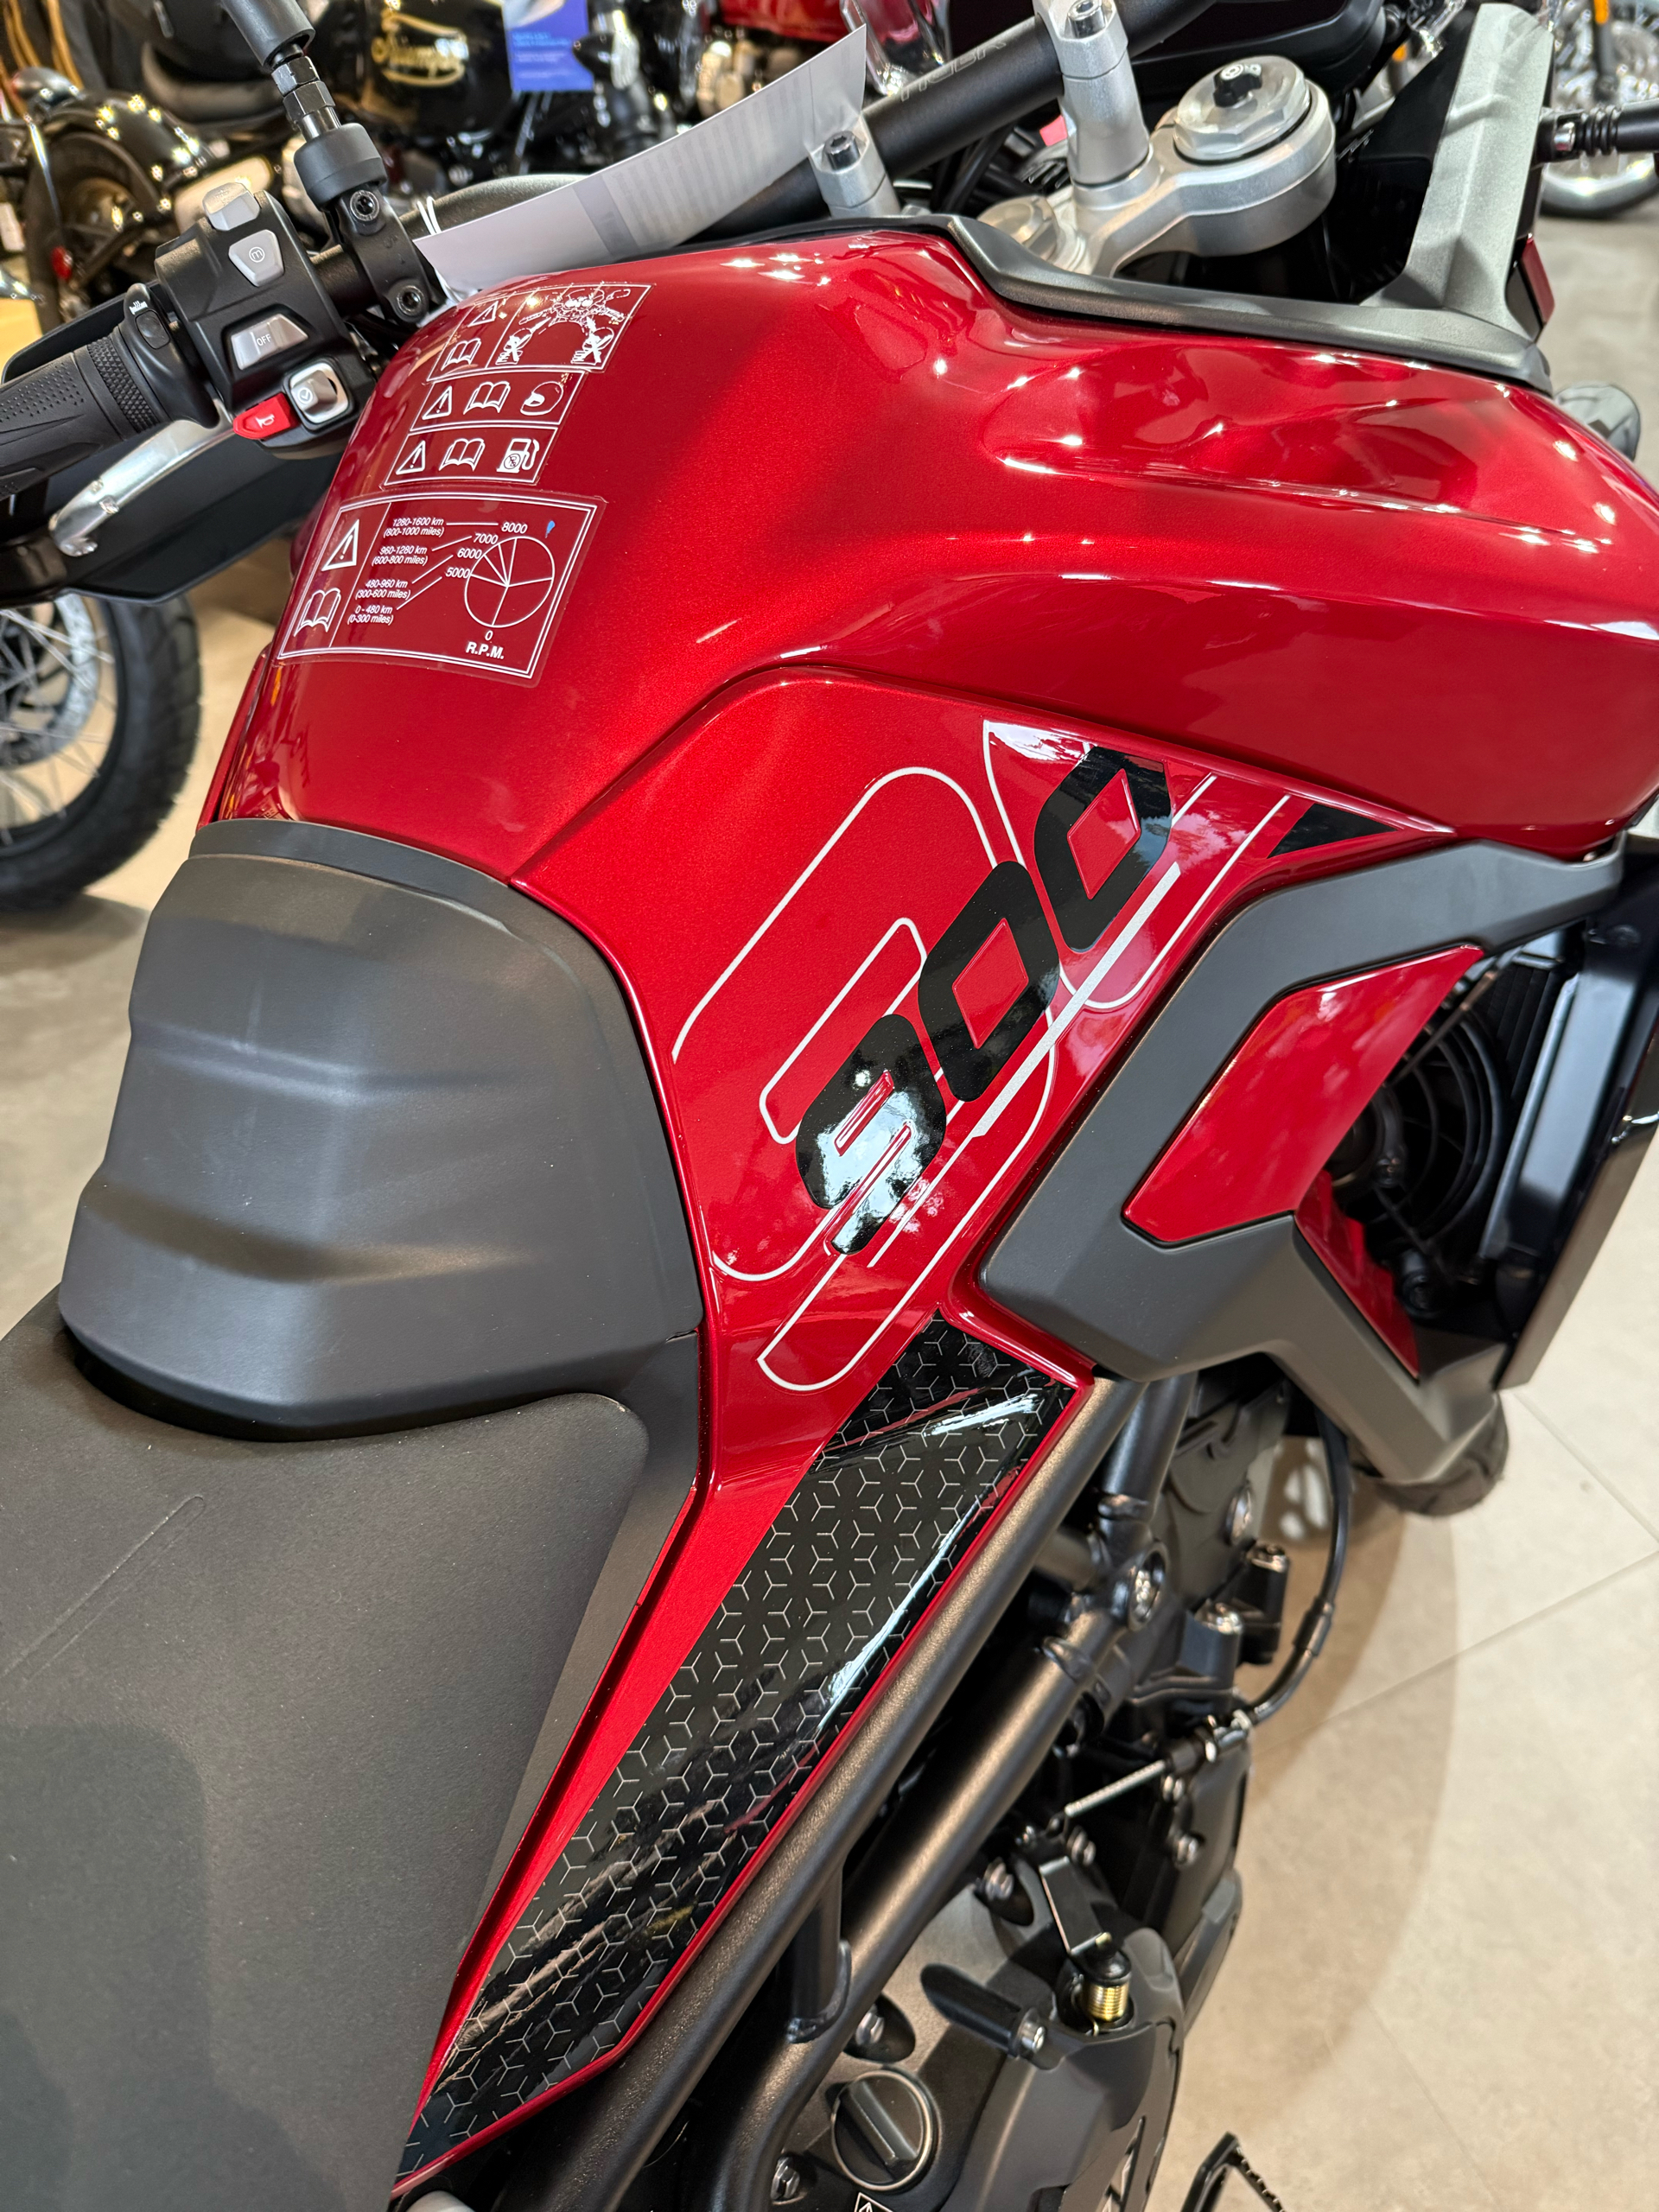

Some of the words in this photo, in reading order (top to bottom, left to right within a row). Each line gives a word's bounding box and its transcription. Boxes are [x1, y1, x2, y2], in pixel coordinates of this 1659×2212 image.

[256, 334, 272, 346] OFF
[393, 518, 431, 527] 1280-1600
[431, 518, 444, 526] km
[501, 522, 528, 534] 8000
[384, 527, 420, 538] (800-1000
[420, 527, 445, 537] miles)
[474, 533, 499, 545] 7000
[379, 546, 415, 556] 960-1280
[415, 546, 428, 555] km
[457, 548, 483, 560] 6000
[372, 556, 404, 566] (600-800
[404, 556, 429, 566] miles)
[446, 567, 471, 579] 5000
[365, 580, 395, 588] 480-960
[395, 580, 409, 588] km
[355, 589, 388, 601] (300-600
[386, 589, 411, 601] miles)
[365, 605, 381, 614] 480
[380, 605, 393, 614] km
[347, 614, 372, 626] (0-300
[370, 615, 394, 626] miles)
[485, 630, 493, 641] 0
[465, 641, 505, 660] R.P.M.
[796, 745, 1173, 1255] 900
